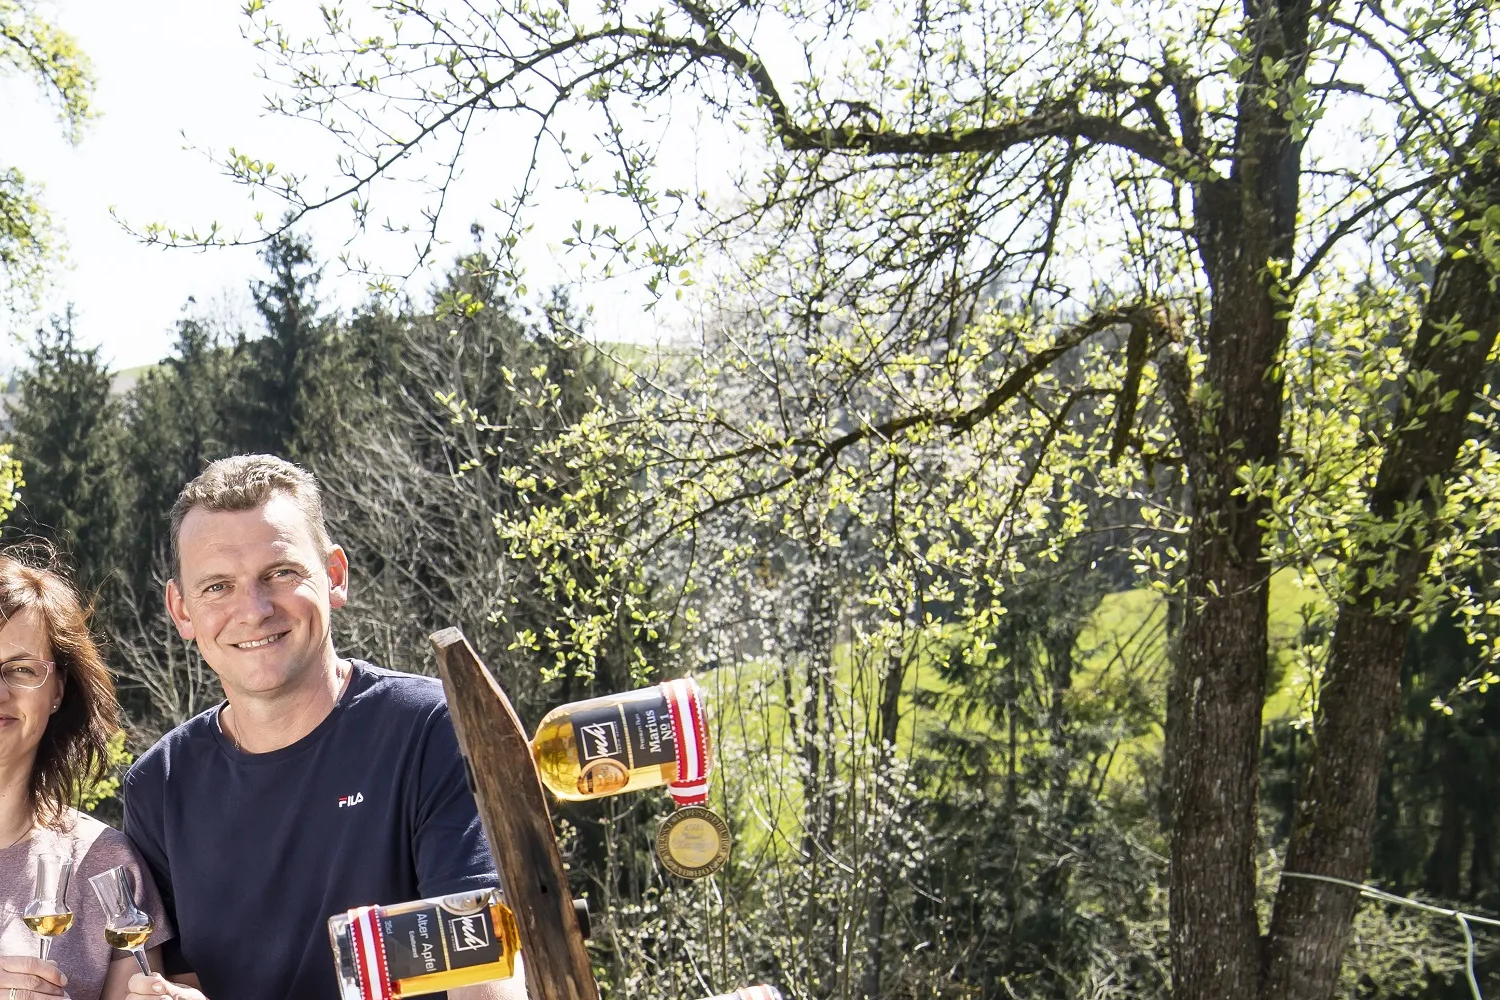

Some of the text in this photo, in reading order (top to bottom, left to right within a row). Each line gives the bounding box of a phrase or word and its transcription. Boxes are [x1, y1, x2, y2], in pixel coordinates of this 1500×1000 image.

[646, 710, 661, 752] Marius
[339, 792, 364, 808] FILA
[409, 931, 418, 957] Edelbrand
[417, 914, 436, 971] Alter Apfel
